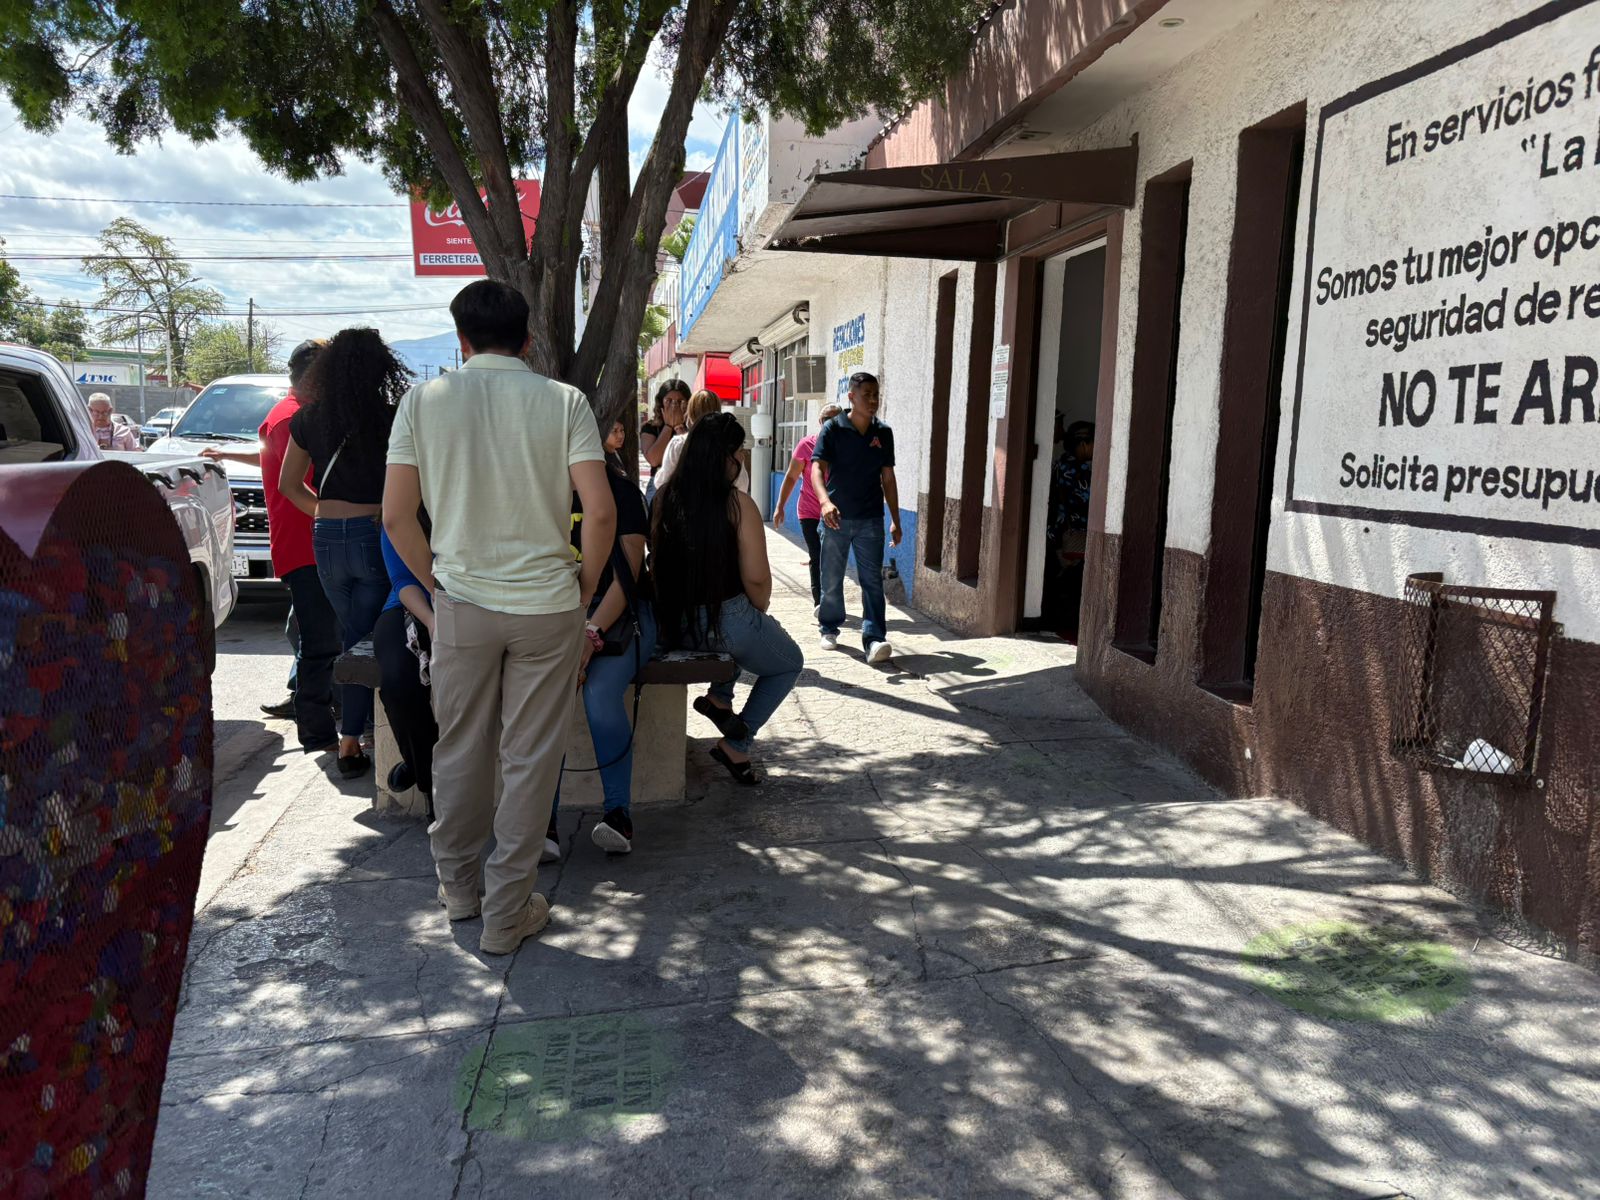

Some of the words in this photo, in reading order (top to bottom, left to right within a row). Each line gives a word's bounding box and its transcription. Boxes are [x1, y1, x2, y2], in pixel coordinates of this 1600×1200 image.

[1386, 120, 1418, 166] En
[1424, 72, 1576, 153] servicios
[1583, 44, 1600, 100] f
[920, 166, 992, 193] SALA
[423, 254, 479, 264] FERRETERA
[446, 237, 472, 245] SIENTE
[1317, 259, 1399, 306] Somos
[1405, 247, 1434, 286] tu
[1438, 226, 1528, 283] mejor
[1534, 215, 1600, 267] opc
[1366, 288, 1508, 353] seguridad
[1513, 281, 1562, 327] de
[1567, 283, 1600, 320] re
[1378, 369, 1437, 427] NO
[1449, 361, 1503, 425] TE
[1511, 355, 1600, 425] AR
[1340, 453, 1439, 492] Solicita
[571, 1030, 619, 1112] SANA
